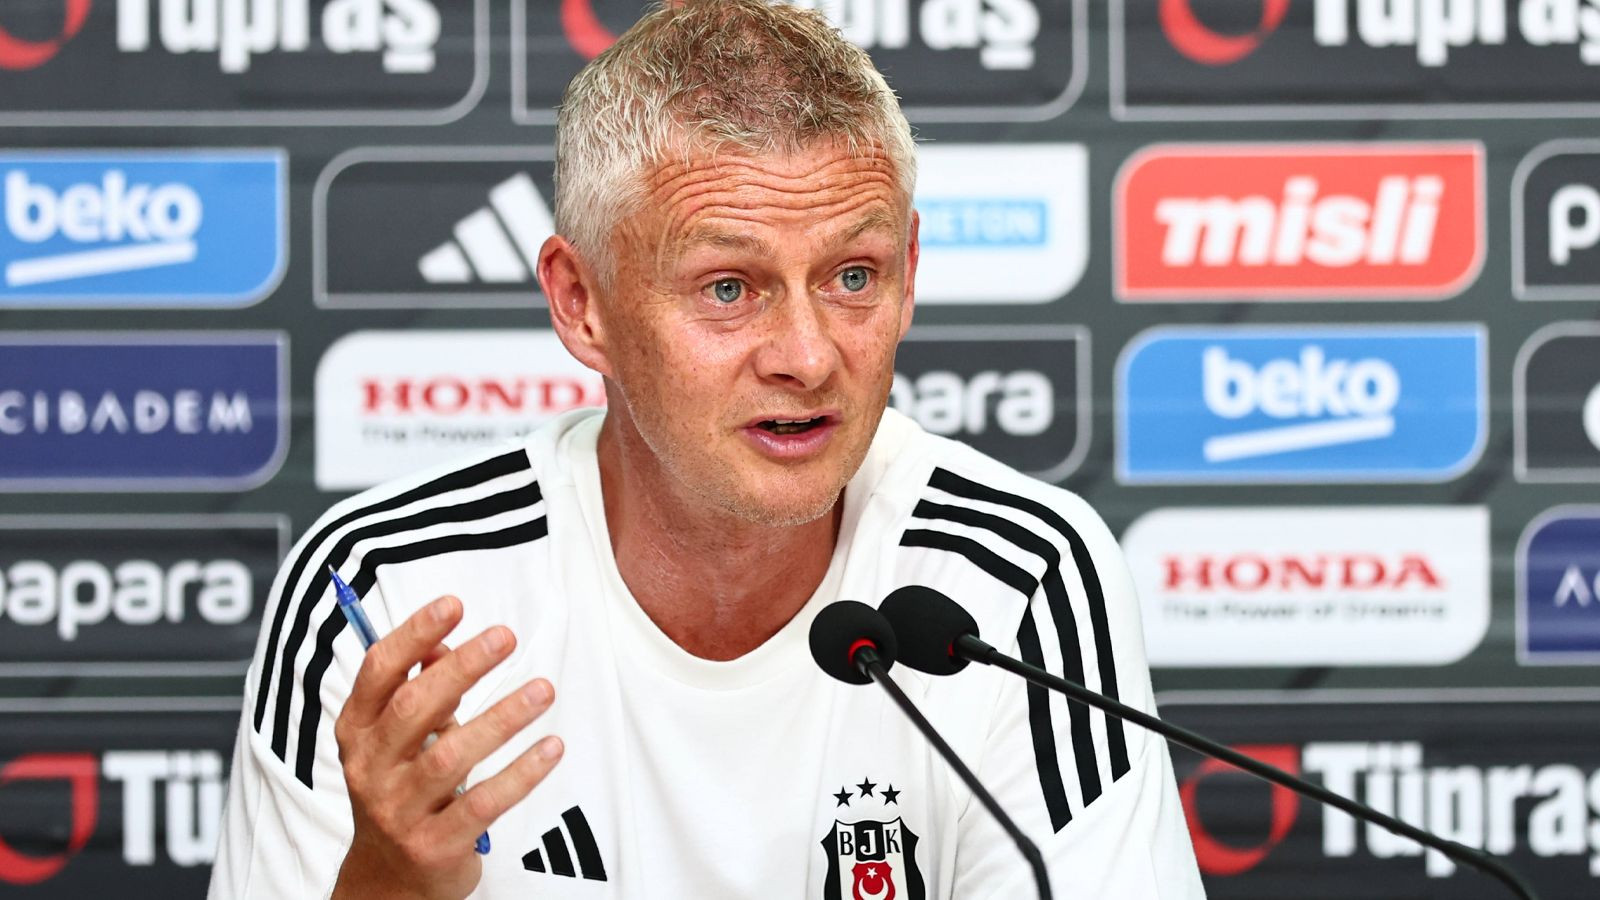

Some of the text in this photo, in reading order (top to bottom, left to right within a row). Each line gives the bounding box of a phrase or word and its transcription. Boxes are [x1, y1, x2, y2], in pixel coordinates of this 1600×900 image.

[4, 169, 203, 243] beko
[1155, 175, 1444, 267] misli
[1202, 345, 1400, 418] beko
[0, 559, 253, 642] apara
[1161, 552, 1447, 592] HONDA
[839, 828, 901, 856] BJK
[1302, 741, 1600, 877] Tüpra
